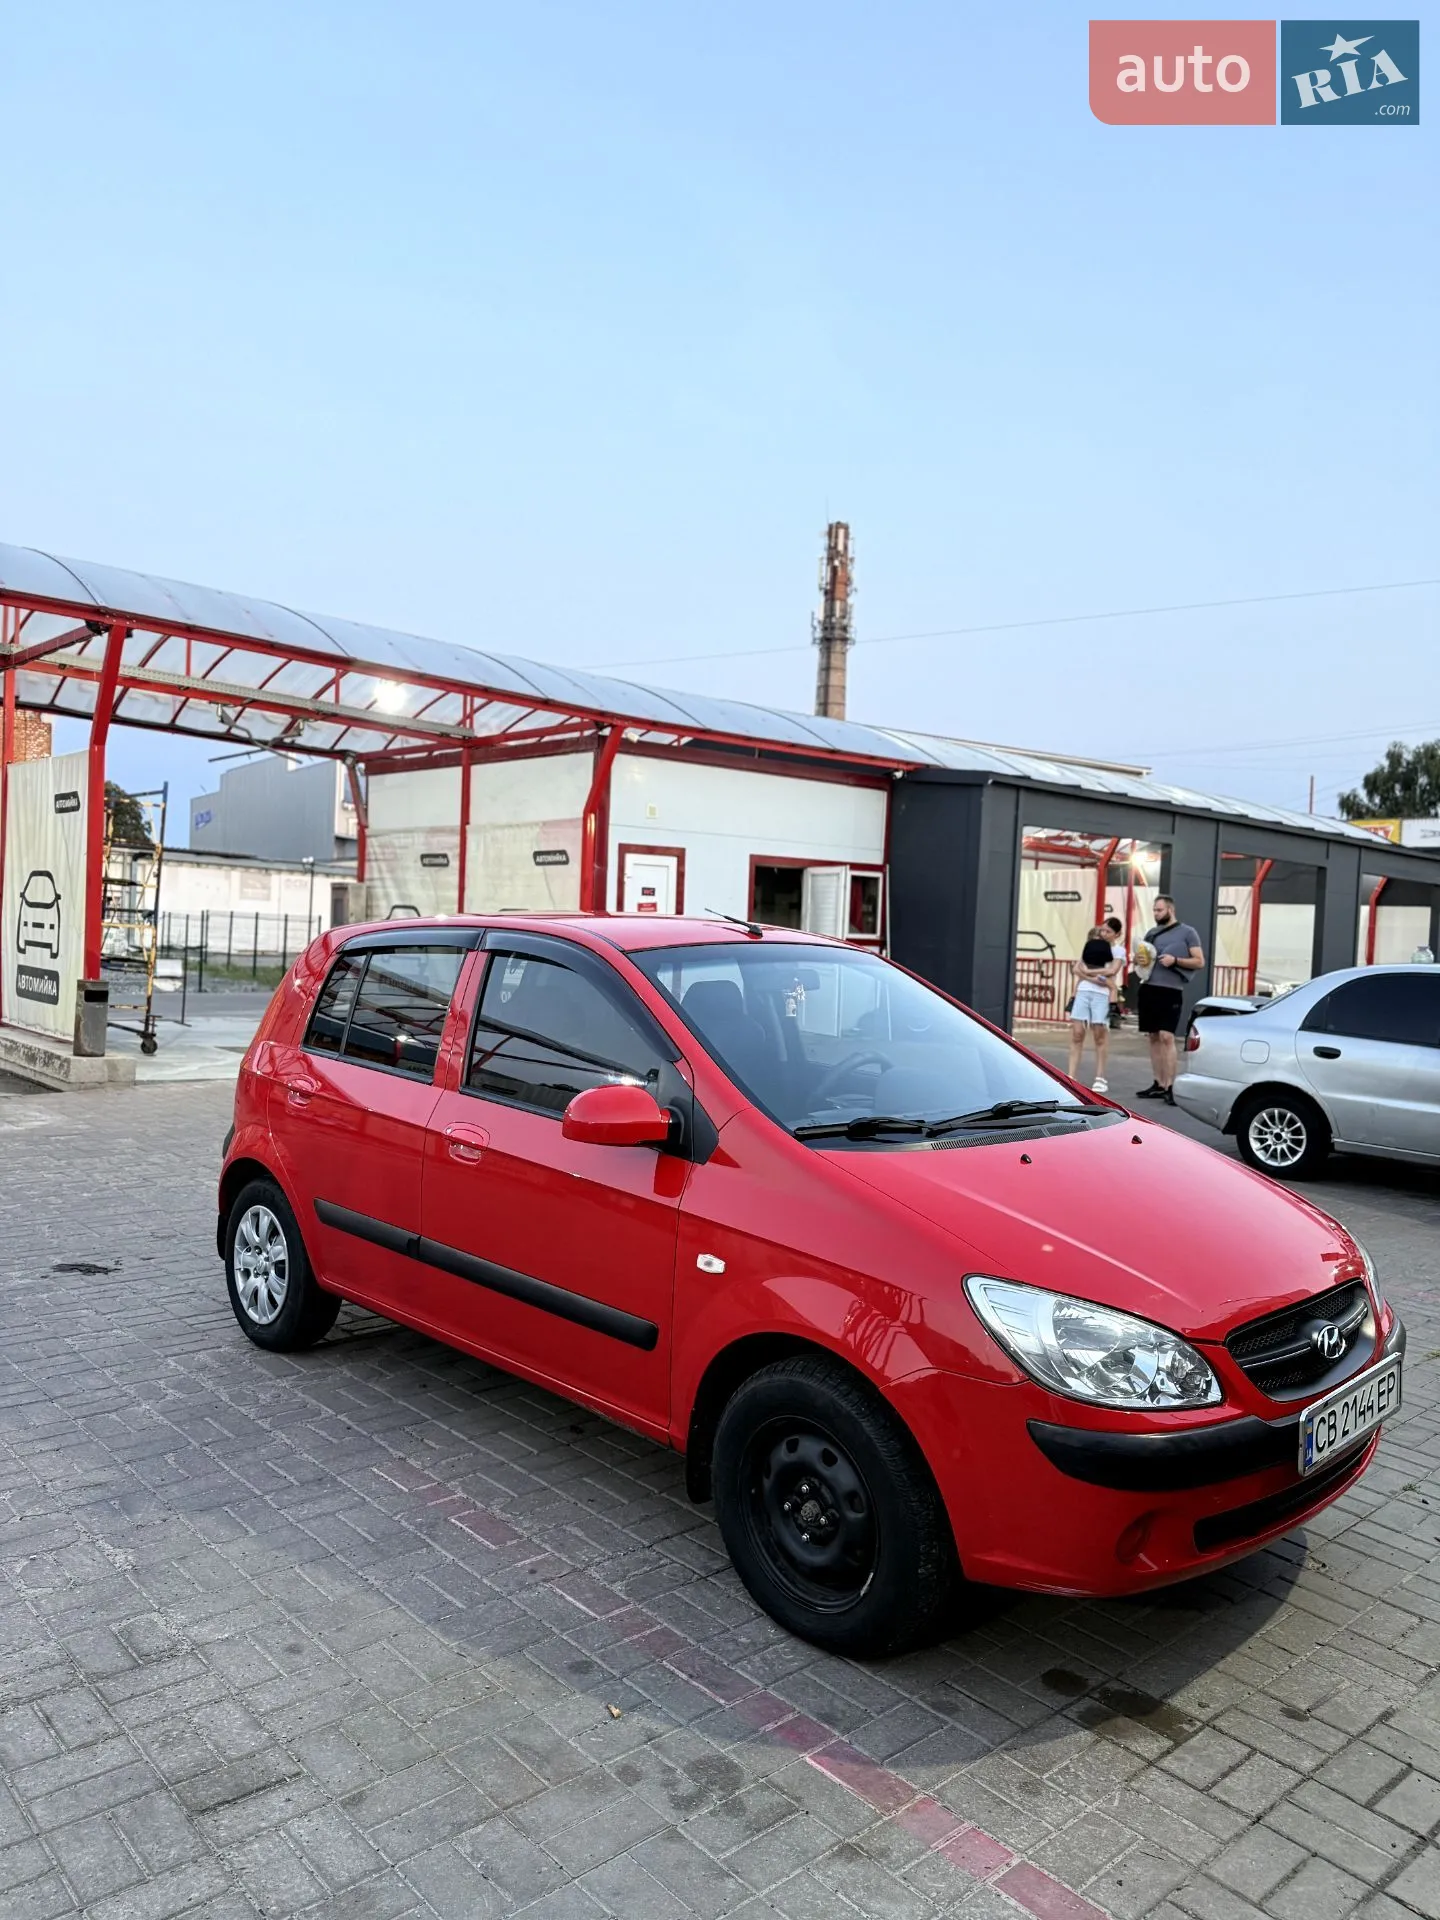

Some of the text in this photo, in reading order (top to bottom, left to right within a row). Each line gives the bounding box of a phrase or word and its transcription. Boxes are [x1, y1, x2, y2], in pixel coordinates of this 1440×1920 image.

[18, 974, 57, 996] АВТОМИЙКА
[1315, 1371, 1396, 1453] CB 2144 EP
